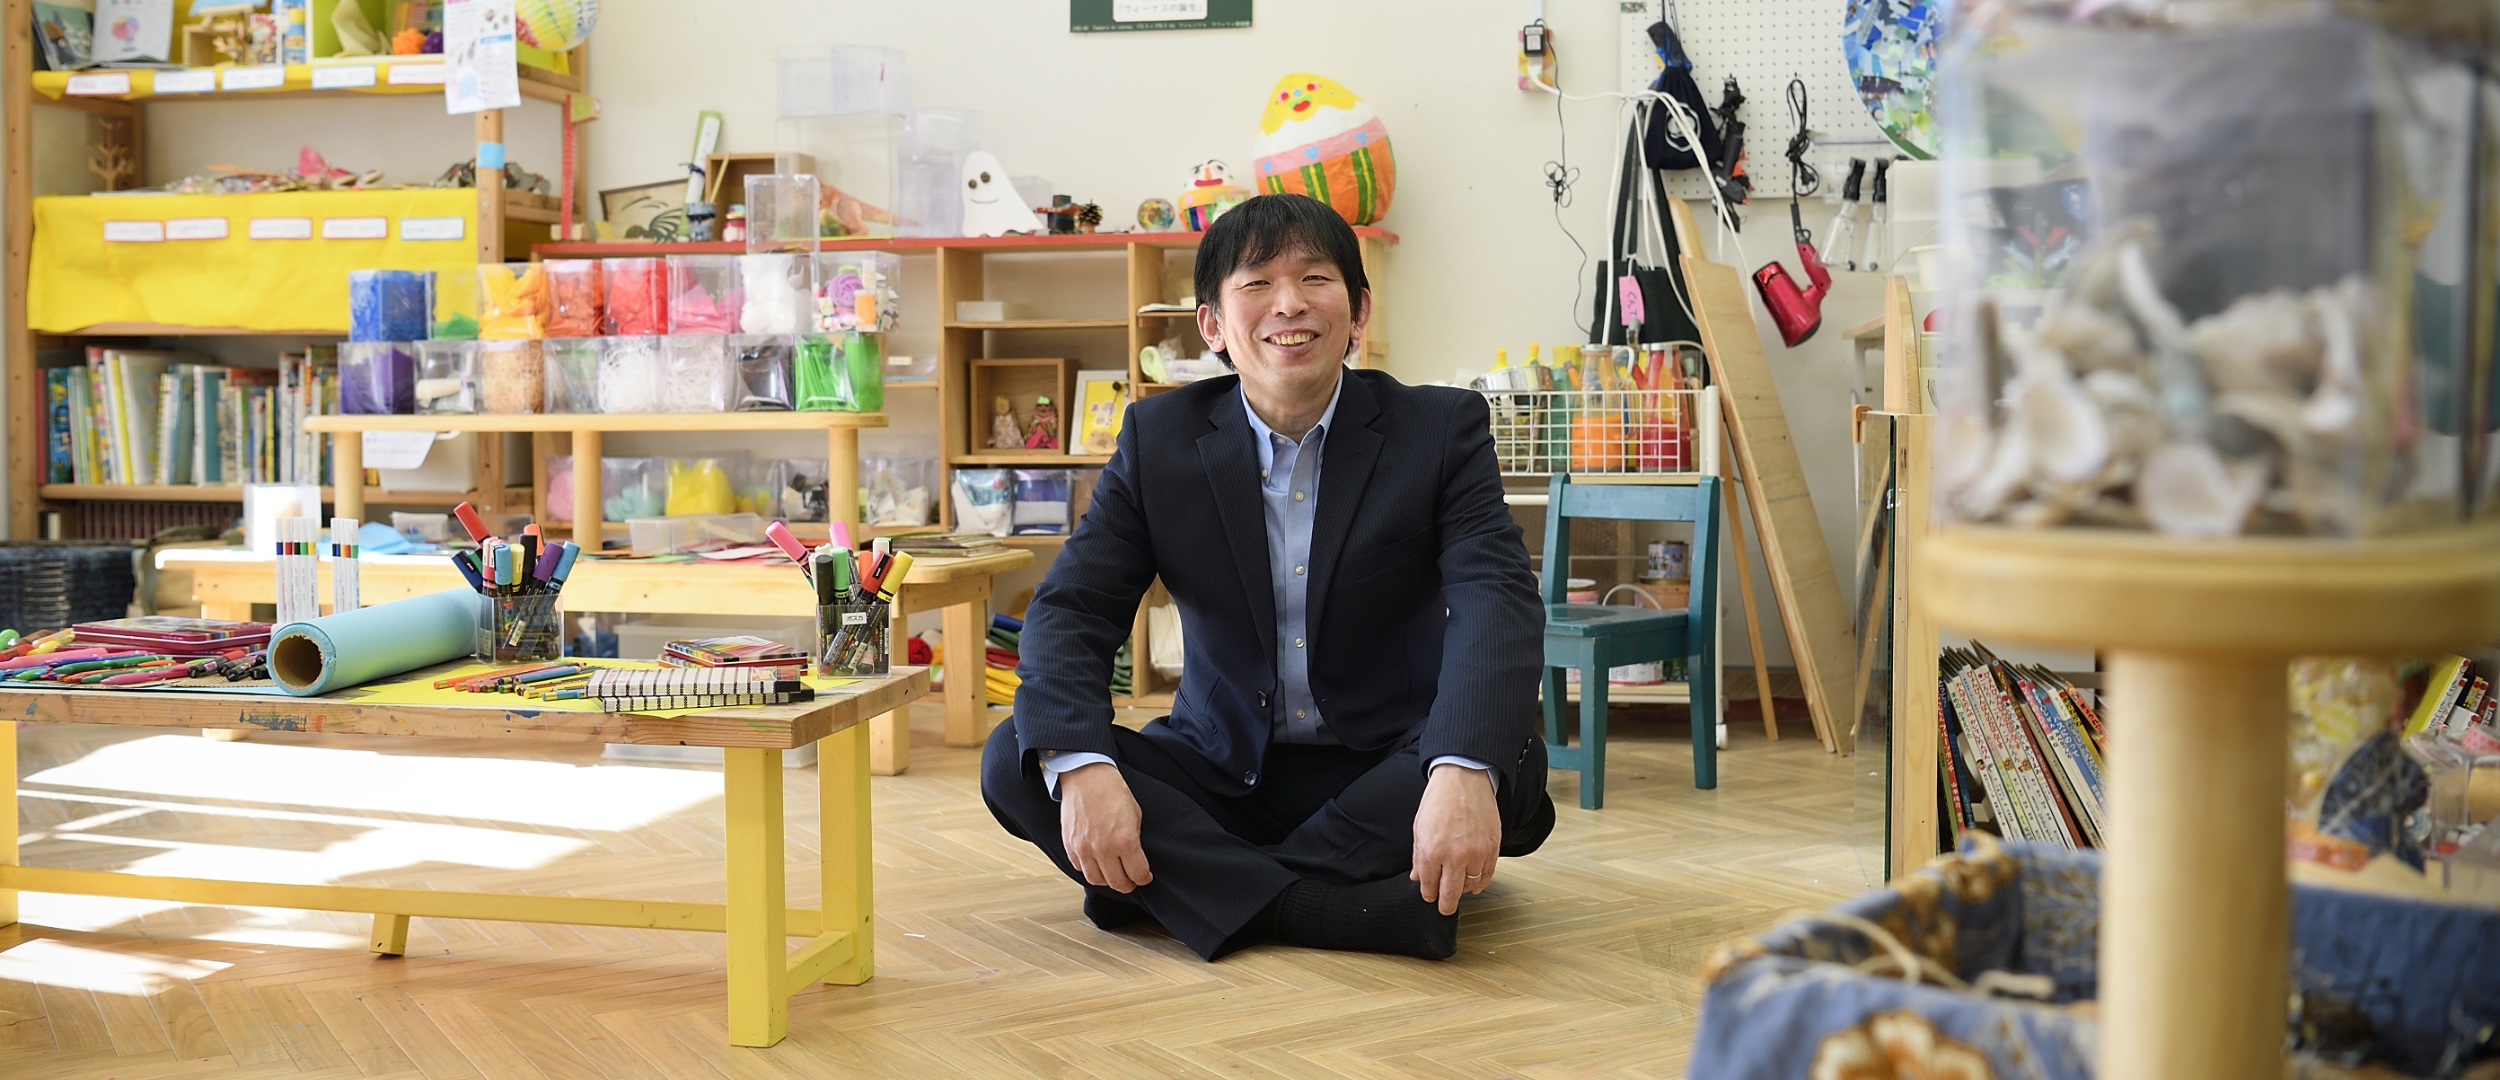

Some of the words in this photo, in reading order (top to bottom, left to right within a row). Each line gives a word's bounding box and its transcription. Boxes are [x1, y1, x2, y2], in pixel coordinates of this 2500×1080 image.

[2052, 713, 2080, 758] バスにのって
